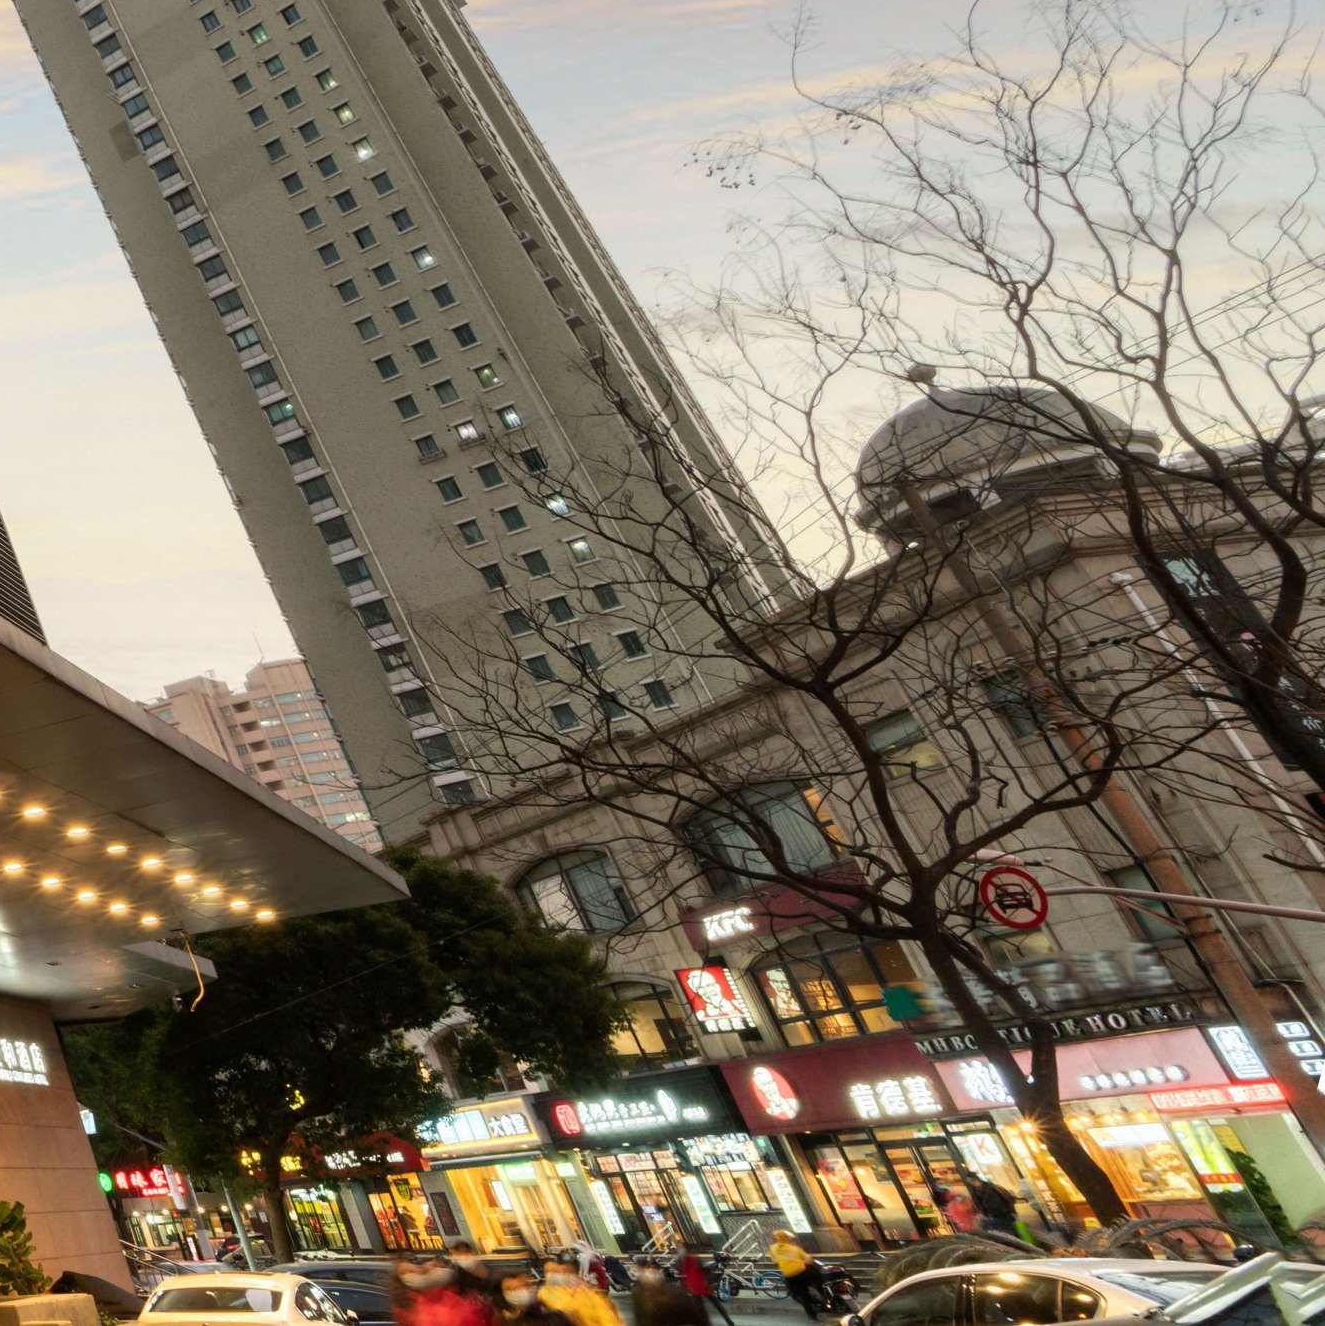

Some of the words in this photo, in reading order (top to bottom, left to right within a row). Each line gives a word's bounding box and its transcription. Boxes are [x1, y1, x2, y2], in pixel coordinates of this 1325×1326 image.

[703, 906, 754, 940] KFC
[1086, 1004, 1193, 1034] HOTEL
[850, 1076, 942, 1119] 肯德基
